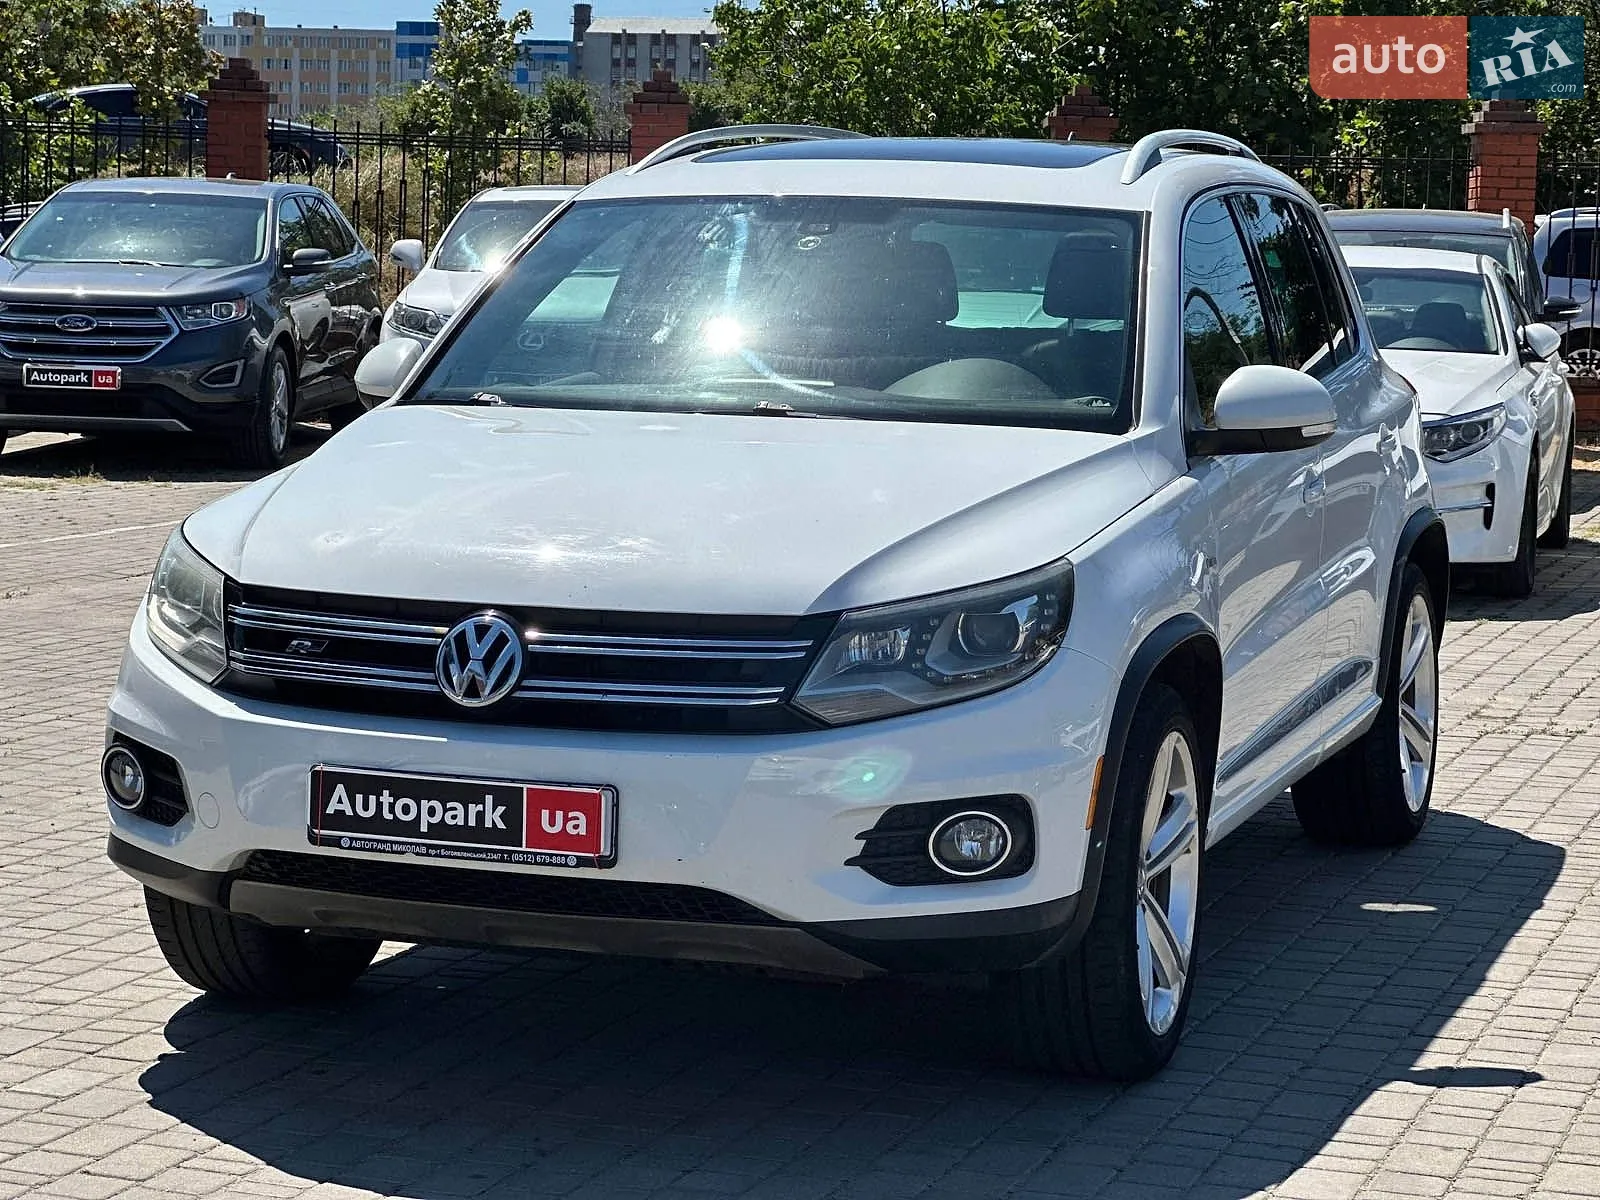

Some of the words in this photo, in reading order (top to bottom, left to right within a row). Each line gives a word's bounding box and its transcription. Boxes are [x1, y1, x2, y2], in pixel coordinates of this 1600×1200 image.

[31, 371, 88, 384] Autopark
[98, 375, 113, 383] ua
[325, 783, 507, 833] Autopark
[541, 808, 587, 836] ua
[351, 840, 392, 852] АВТОГРАНД
[511, 853, 535, 864] (0512)
[536, 855, 566, 865] 679-888
